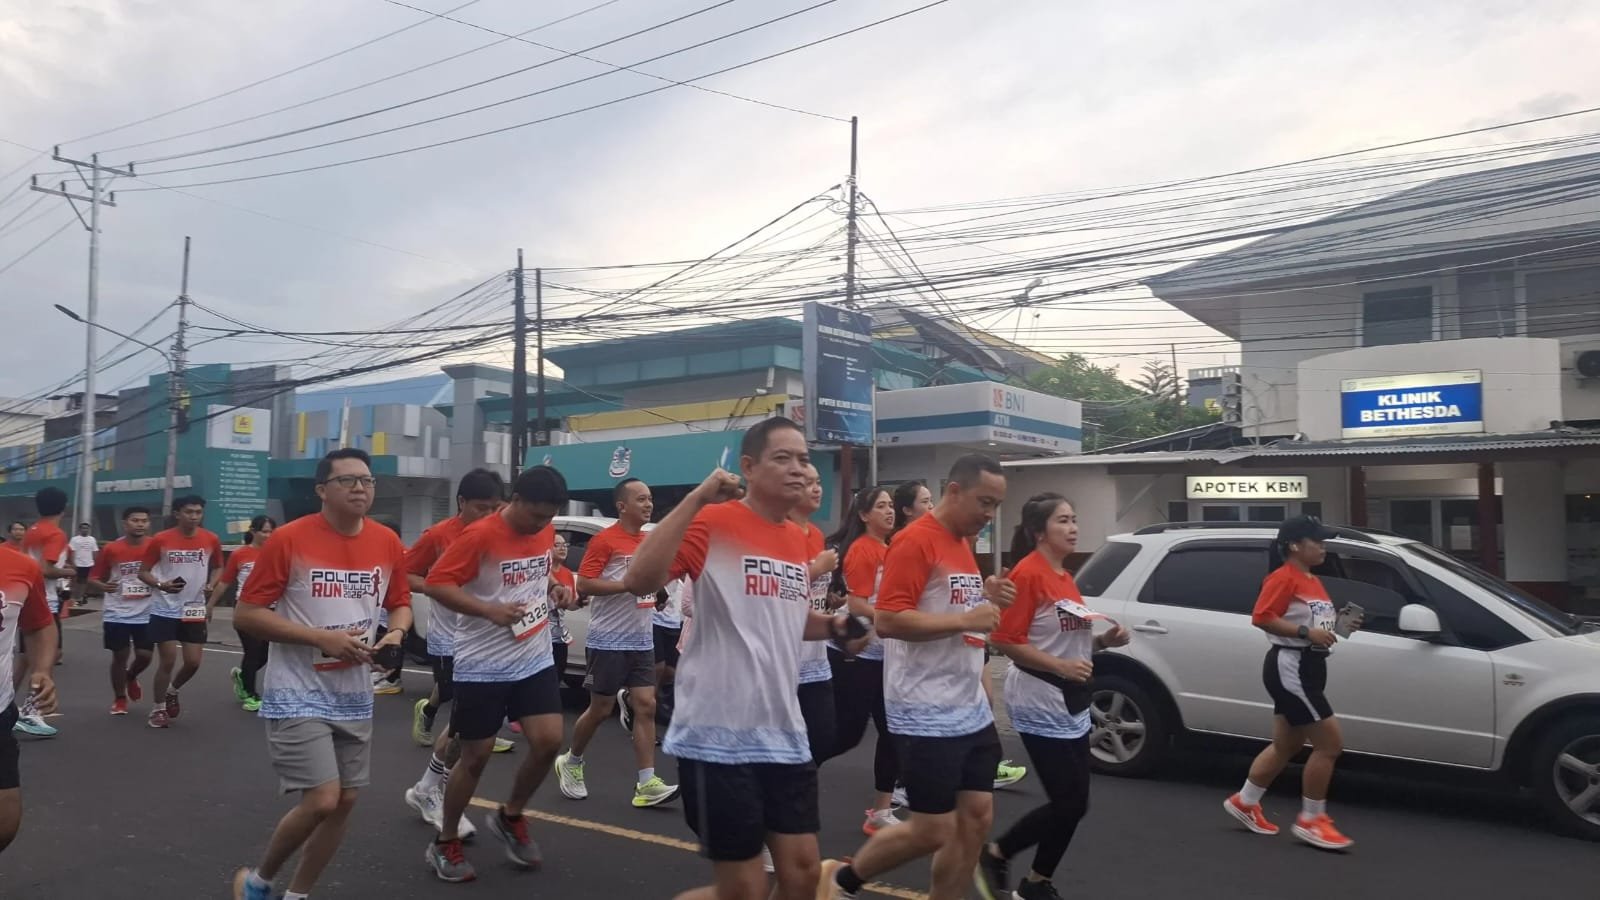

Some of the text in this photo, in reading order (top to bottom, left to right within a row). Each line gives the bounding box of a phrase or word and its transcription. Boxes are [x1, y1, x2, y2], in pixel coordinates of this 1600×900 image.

[1005, 391, 1025, 413] BNI
[1377, 391, 1442, 406] KLINIK
[1360, 404, 1462, 422] BETHESDA
[1192, 482, 1303, 493] APOTEK KBM
[502, 557, 546, 573] POLICE
[743, 558, 804, 582] POLICE
[311, 570, 371, 583] POLICE
[502, 571, 526, 587] RUN
[311, 583, 372, 598] RUN SULUT
[745, 574, 779, 598] RUN
[343, 591, 362, 599] 2026
[521, 602, 548, 627] 1329
